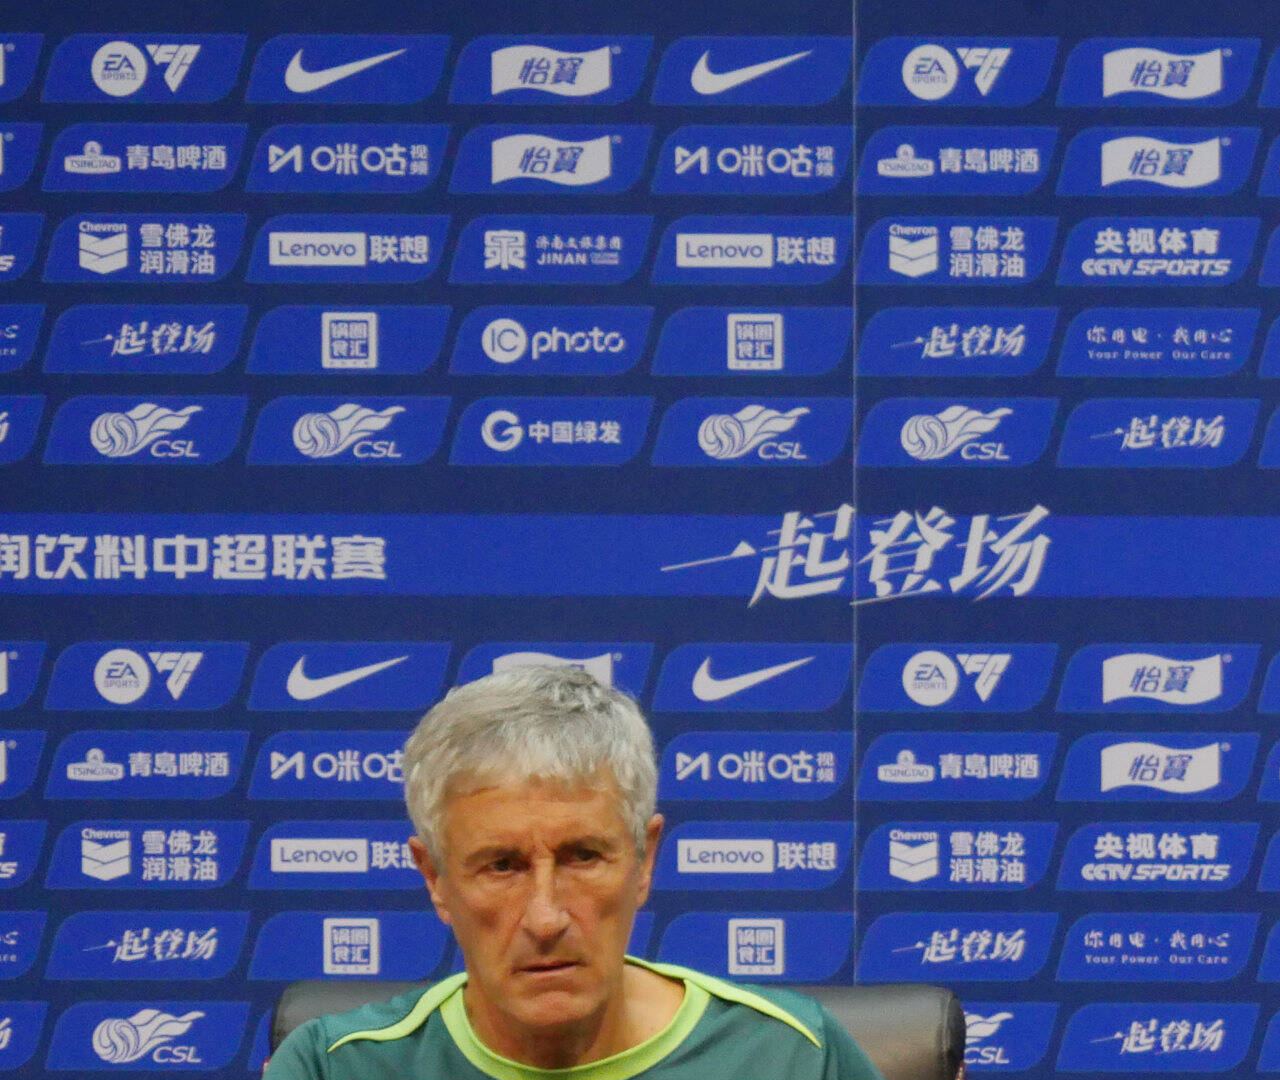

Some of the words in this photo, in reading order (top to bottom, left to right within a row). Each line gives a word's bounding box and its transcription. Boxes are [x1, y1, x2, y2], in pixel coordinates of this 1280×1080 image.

[103, 55, 133, 70] EA
[914, 59, 944, 74] EA
[126, 144, 226, 170] 青岛啤酒
[939, 147, 1039, 173] 青岛啤酒
[79, 222, 126, 232] Chevron
[140, 224, 216, 248] 雪佛龙
[889, 224, 936, 236] Chevron
[950, 226, 1026, 251] 雪佛龙
[279, 240, 356, 258] Lenovo
[370, 235, 428, 262] 联想
[686, 242, 764, 258] Lenovo
[776, 236, 835, 264] 联想
[1095, 228, 1218, 254] 央视体育
[140, 250, 216, 274] 润滑油
[536, 252, 587, 265] JINAN
[950, 253, 1026, 278] 润滑油
[1133, 258, 1230, 276] SPORTS
[82, 322, 216, 360] 一起登场
[892, 324, 1026, 363] 一起登场
[528, 421, 620, 444] 中国绿发
[1090, 417, 1225, 450] 一起登场
[152, 440, 198, 458] CSL
[758, 442, 805, 460] CSL
[661, 503, 1050, 607] 一起登场
[106, 663, 136, 678] EA
[914, 665, 944, 680] EA
[128, 751, 228, 777] 青岛啤酒
[939, 753, 1039, 779] 青岛啤酒
[142, 830, 218, 855] 雪佛龙
[280, 846, 358, 864] Lenovo
[950, 832, 1026, 856] 雪佛龙
[1095, 833, 1218, 859] 央视体育
[687, 848, 764, 864] Lenovo
[778, 842, 836, 870] 联想
[142, 857, 218, 882] 润滑油
[950, 858, 1026, 882] 润滑油
[1133, 864, 1230, 880] SPORTS
[84, 928, 218, 966] 一起登场
[892, 930, 1026, 968] 一起登场
[1090, 1021, 1225, 1054] 一起登场
[154, 1046, 200, 1064] CSL
